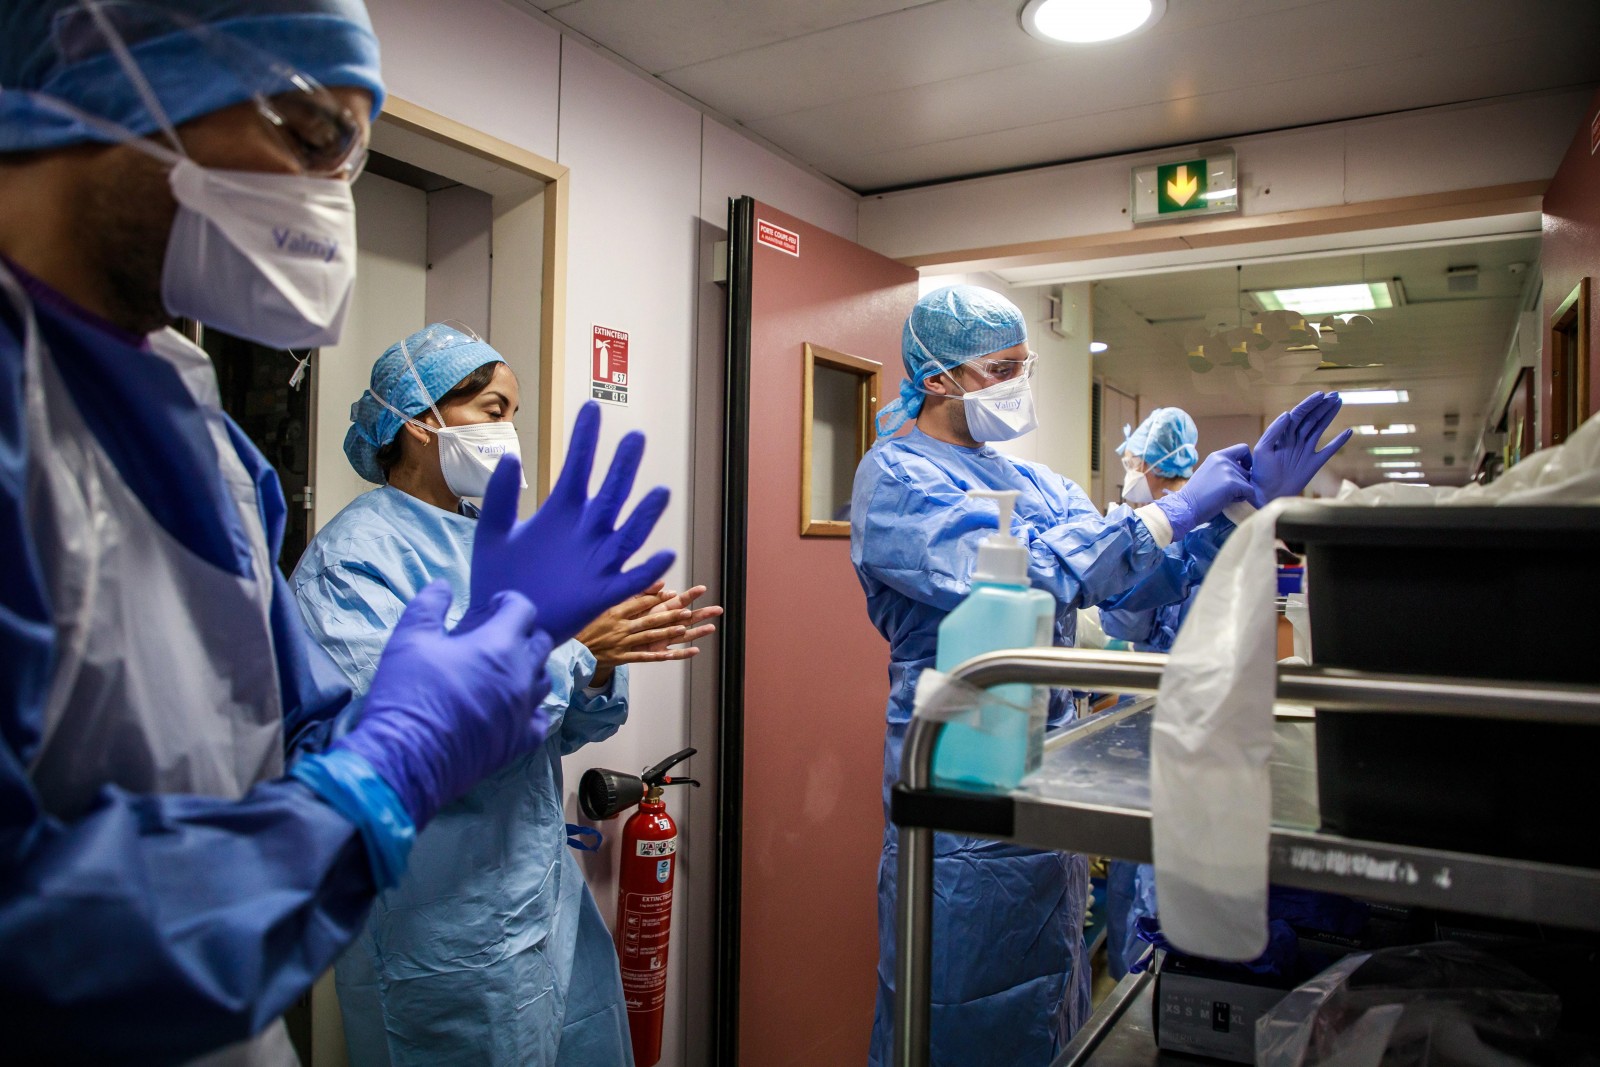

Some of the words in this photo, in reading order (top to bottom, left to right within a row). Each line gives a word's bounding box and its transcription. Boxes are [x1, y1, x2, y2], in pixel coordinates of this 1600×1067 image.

[760, 225, 774, 236] PORTE
[774, 231, 797, 245] COUPE-FEU
[272, 227, 339, 263] Valmy
[594, 326, 628, 341] EXTINCTEUR
[617, 373, 626, 383] 57
[994, 398, 1022, 410] Valmy
[477, 444, 506, 454] Valmy
[659, 819, 669, 830] 57
[1165, 1003, 1181, 1015] XS
[1185, 1007, 1193, 1017] S
[1200, 1009, 1210, 1020] M
[1217, 1012, 1226, 1022] L
[1231, 1014, 1245, 1025] XL
